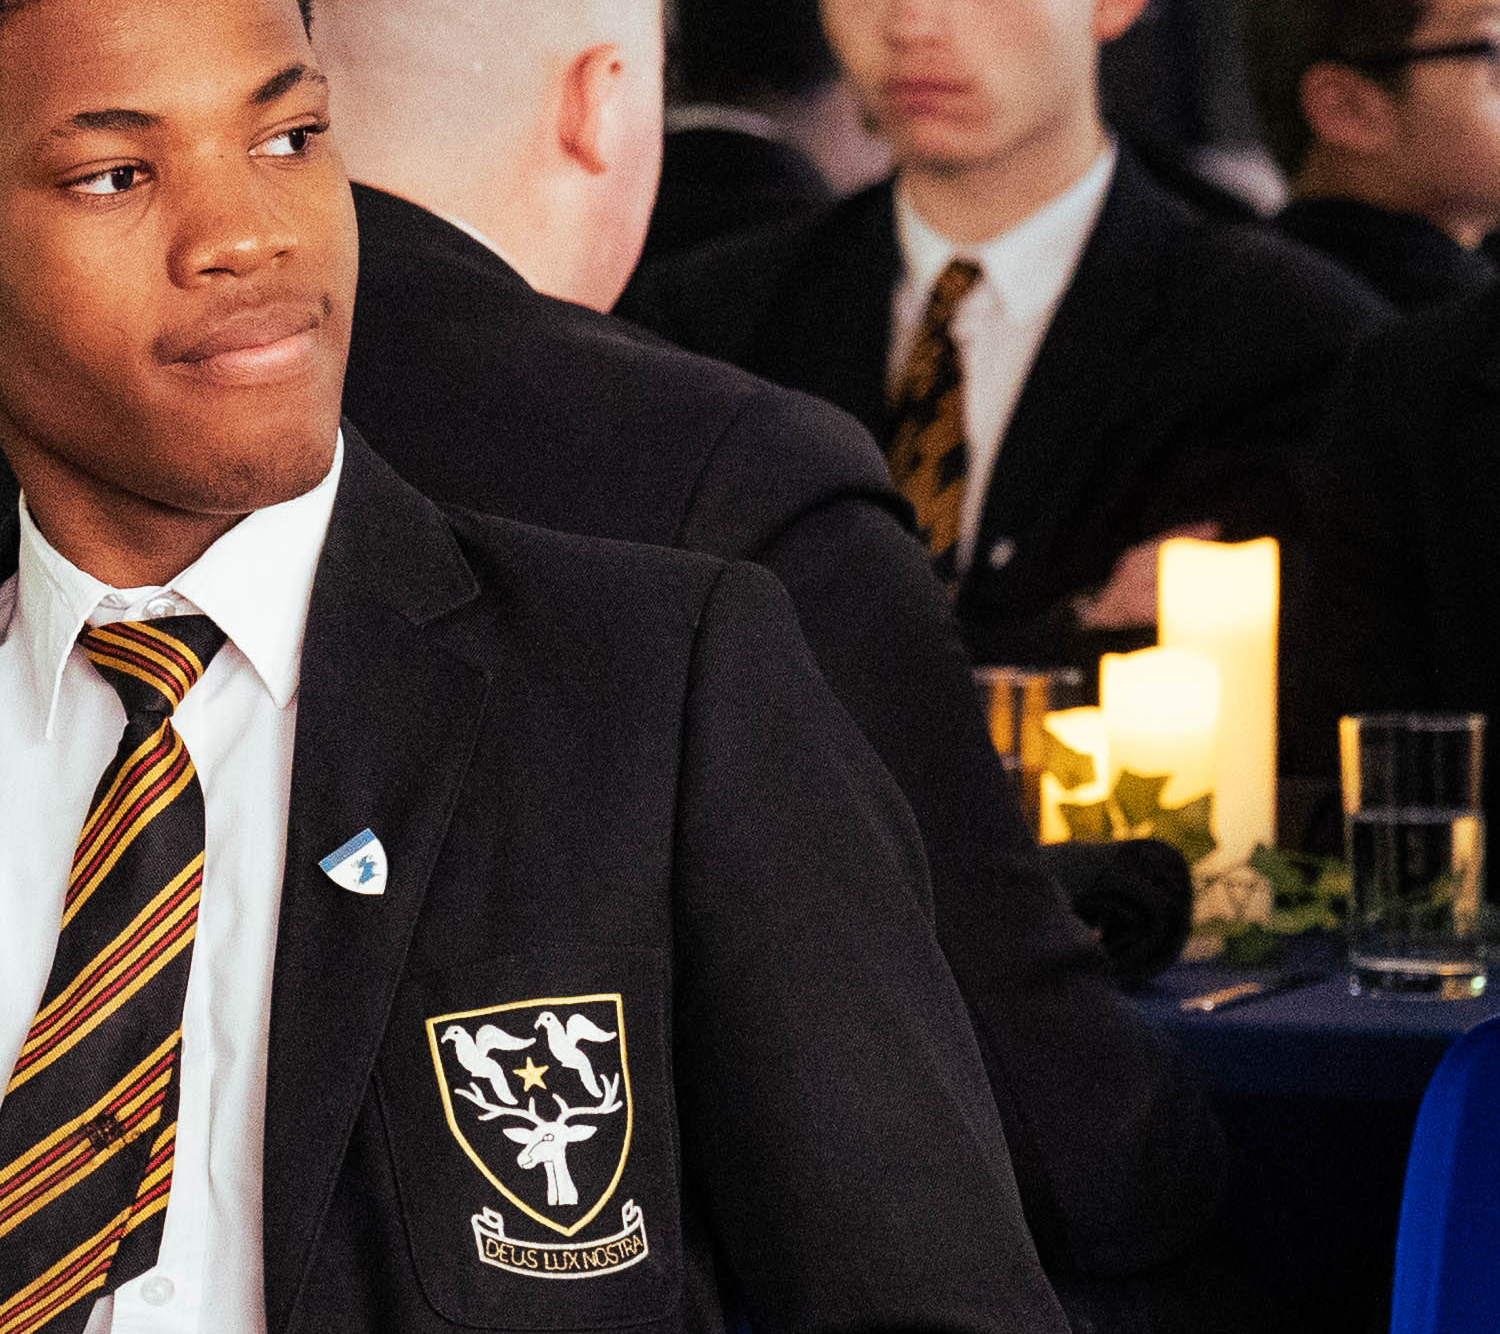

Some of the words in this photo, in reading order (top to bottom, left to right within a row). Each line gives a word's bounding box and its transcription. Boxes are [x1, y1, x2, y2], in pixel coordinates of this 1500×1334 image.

[485, 1238, 538, 1268] DEUS
[543, 1251, 580, 1271] LUX
[582, 1234, 643, 1269] NOSTRA
